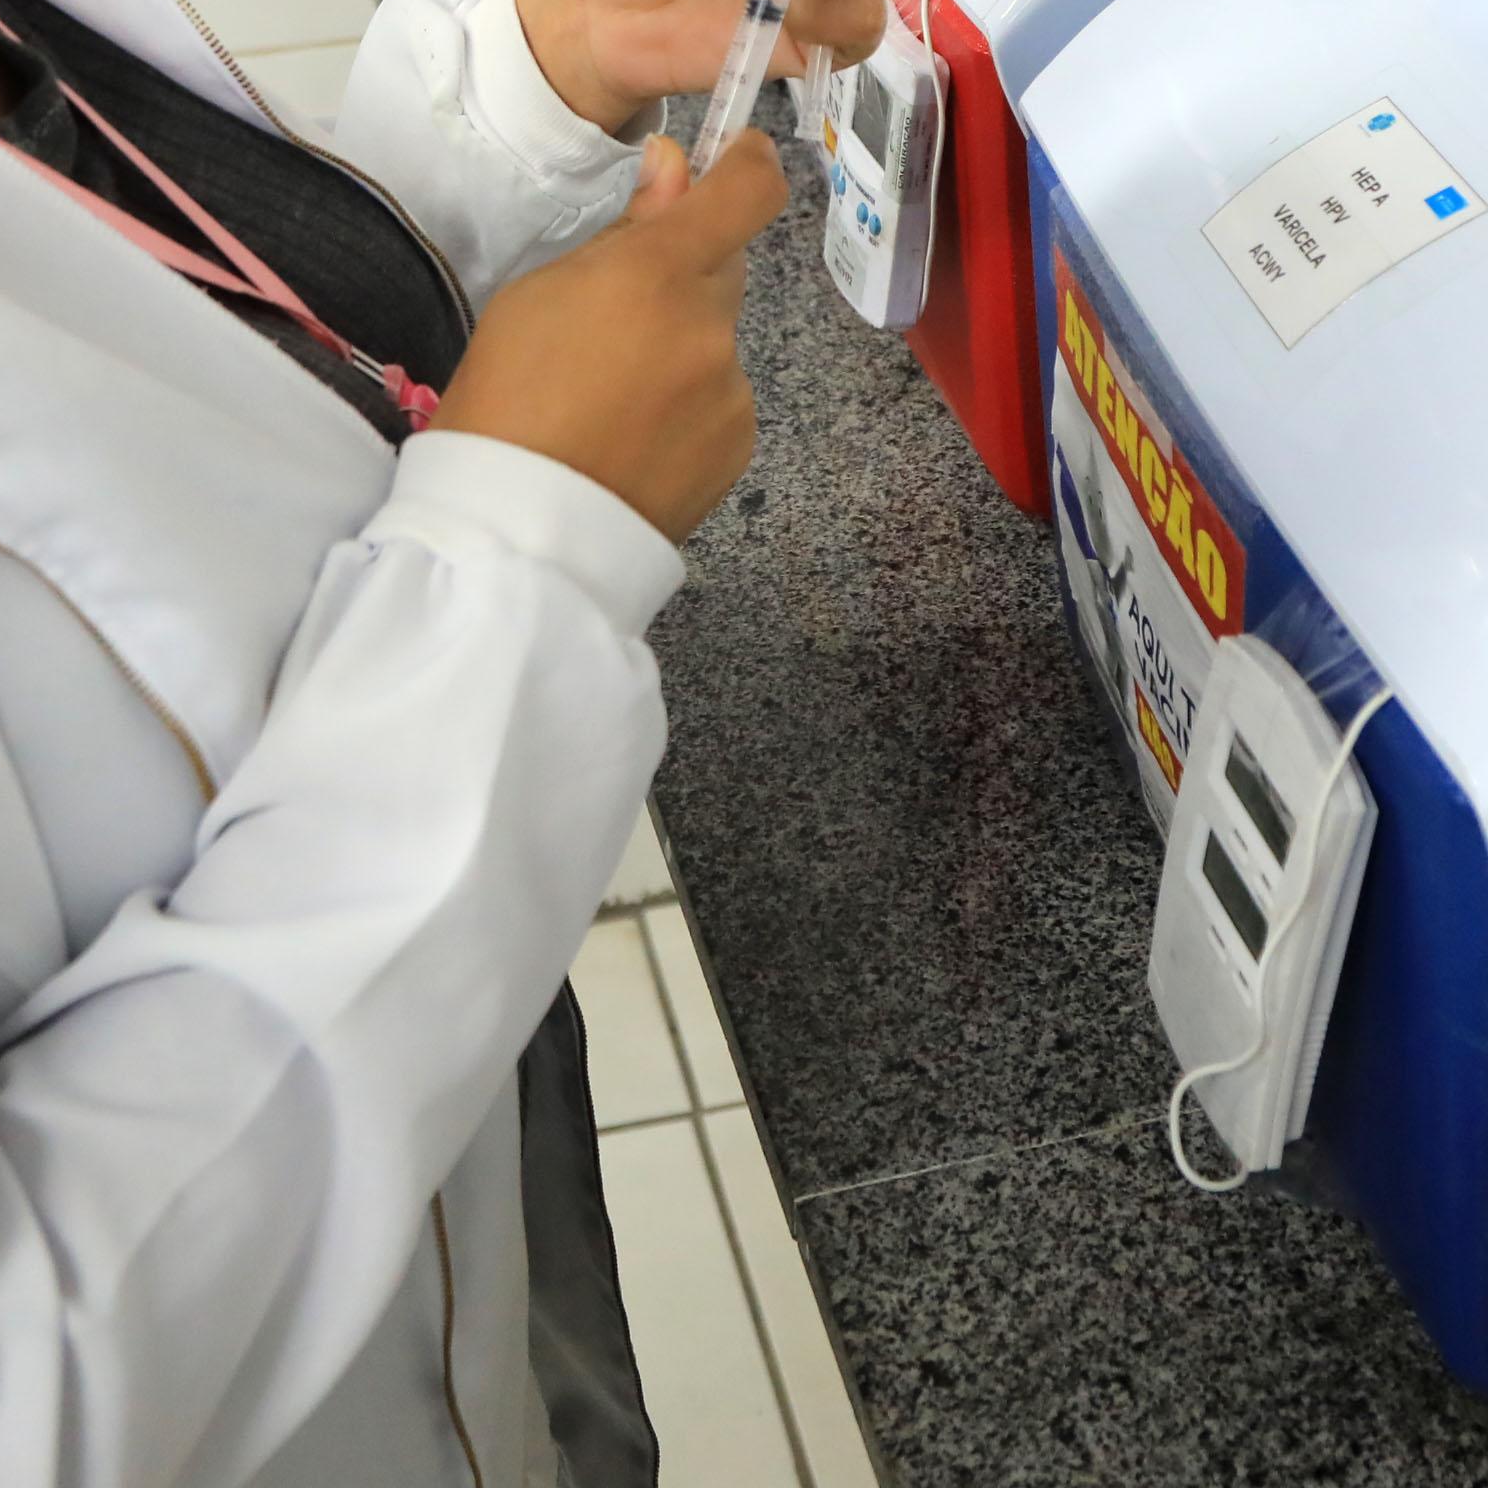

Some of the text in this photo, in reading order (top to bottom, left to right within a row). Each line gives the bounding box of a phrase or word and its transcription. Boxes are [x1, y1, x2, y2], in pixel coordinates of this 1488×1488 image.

[1319, 195, 1351, 226] HPV
[1350, 166, 1382, 196] HEP
[1373, 191, 1390, 209] A
[1247, 243, 1286, 284] ACWY
[1272, 203, 1327, 270] VARICELA
[1064, 287, 1228, 622] ATENÇÃO
[1128, 592, 1175, 702] AQUI
